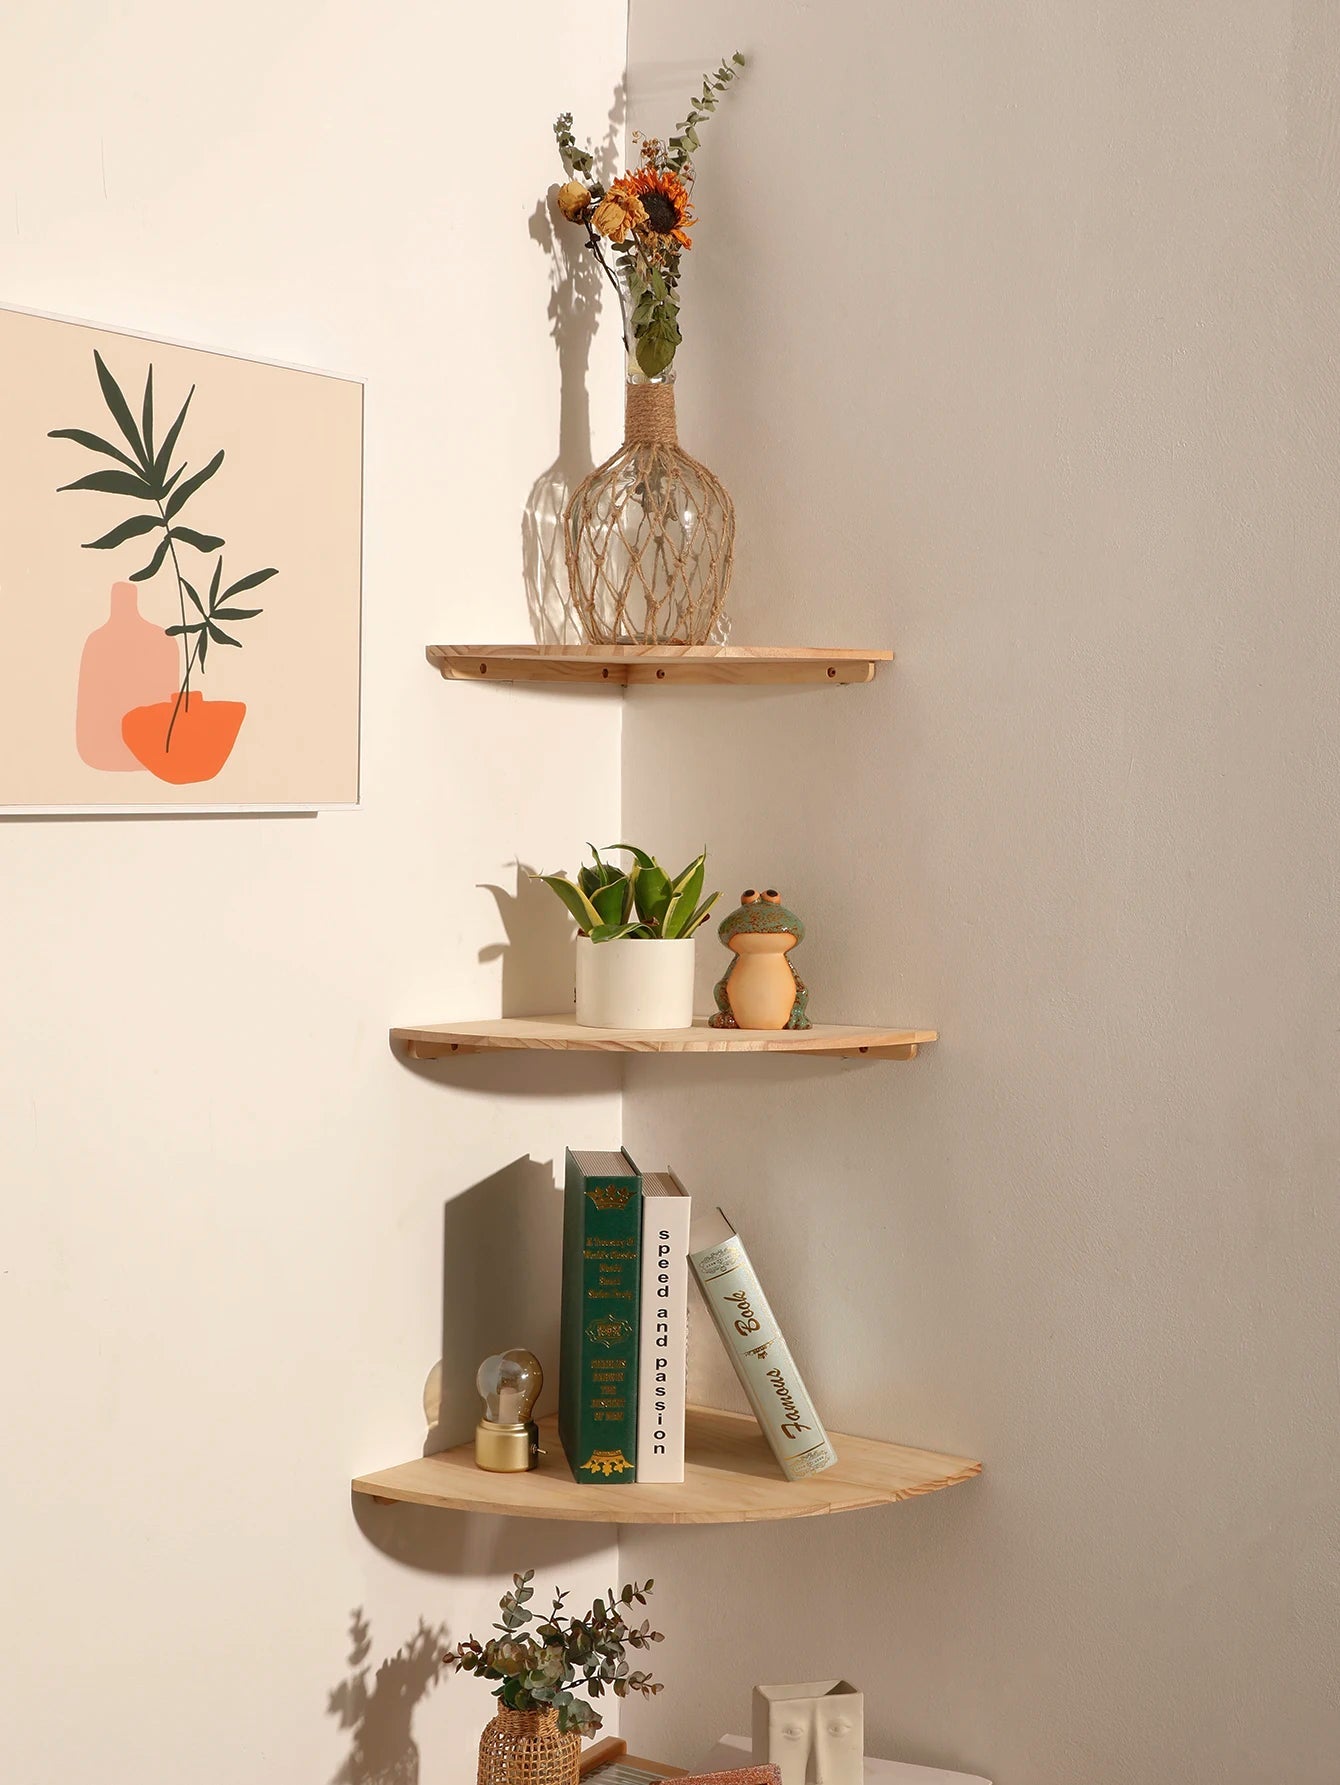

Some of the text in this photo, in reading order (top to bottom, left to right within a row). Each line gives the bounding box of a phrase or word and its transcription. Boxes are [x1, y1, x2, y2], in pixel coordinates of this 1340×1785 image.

[653, 1230, 670, 1454] speed and passion
[723, 1289, 761, 1337] Book
[766, 1367, 812, 1440] Famous
